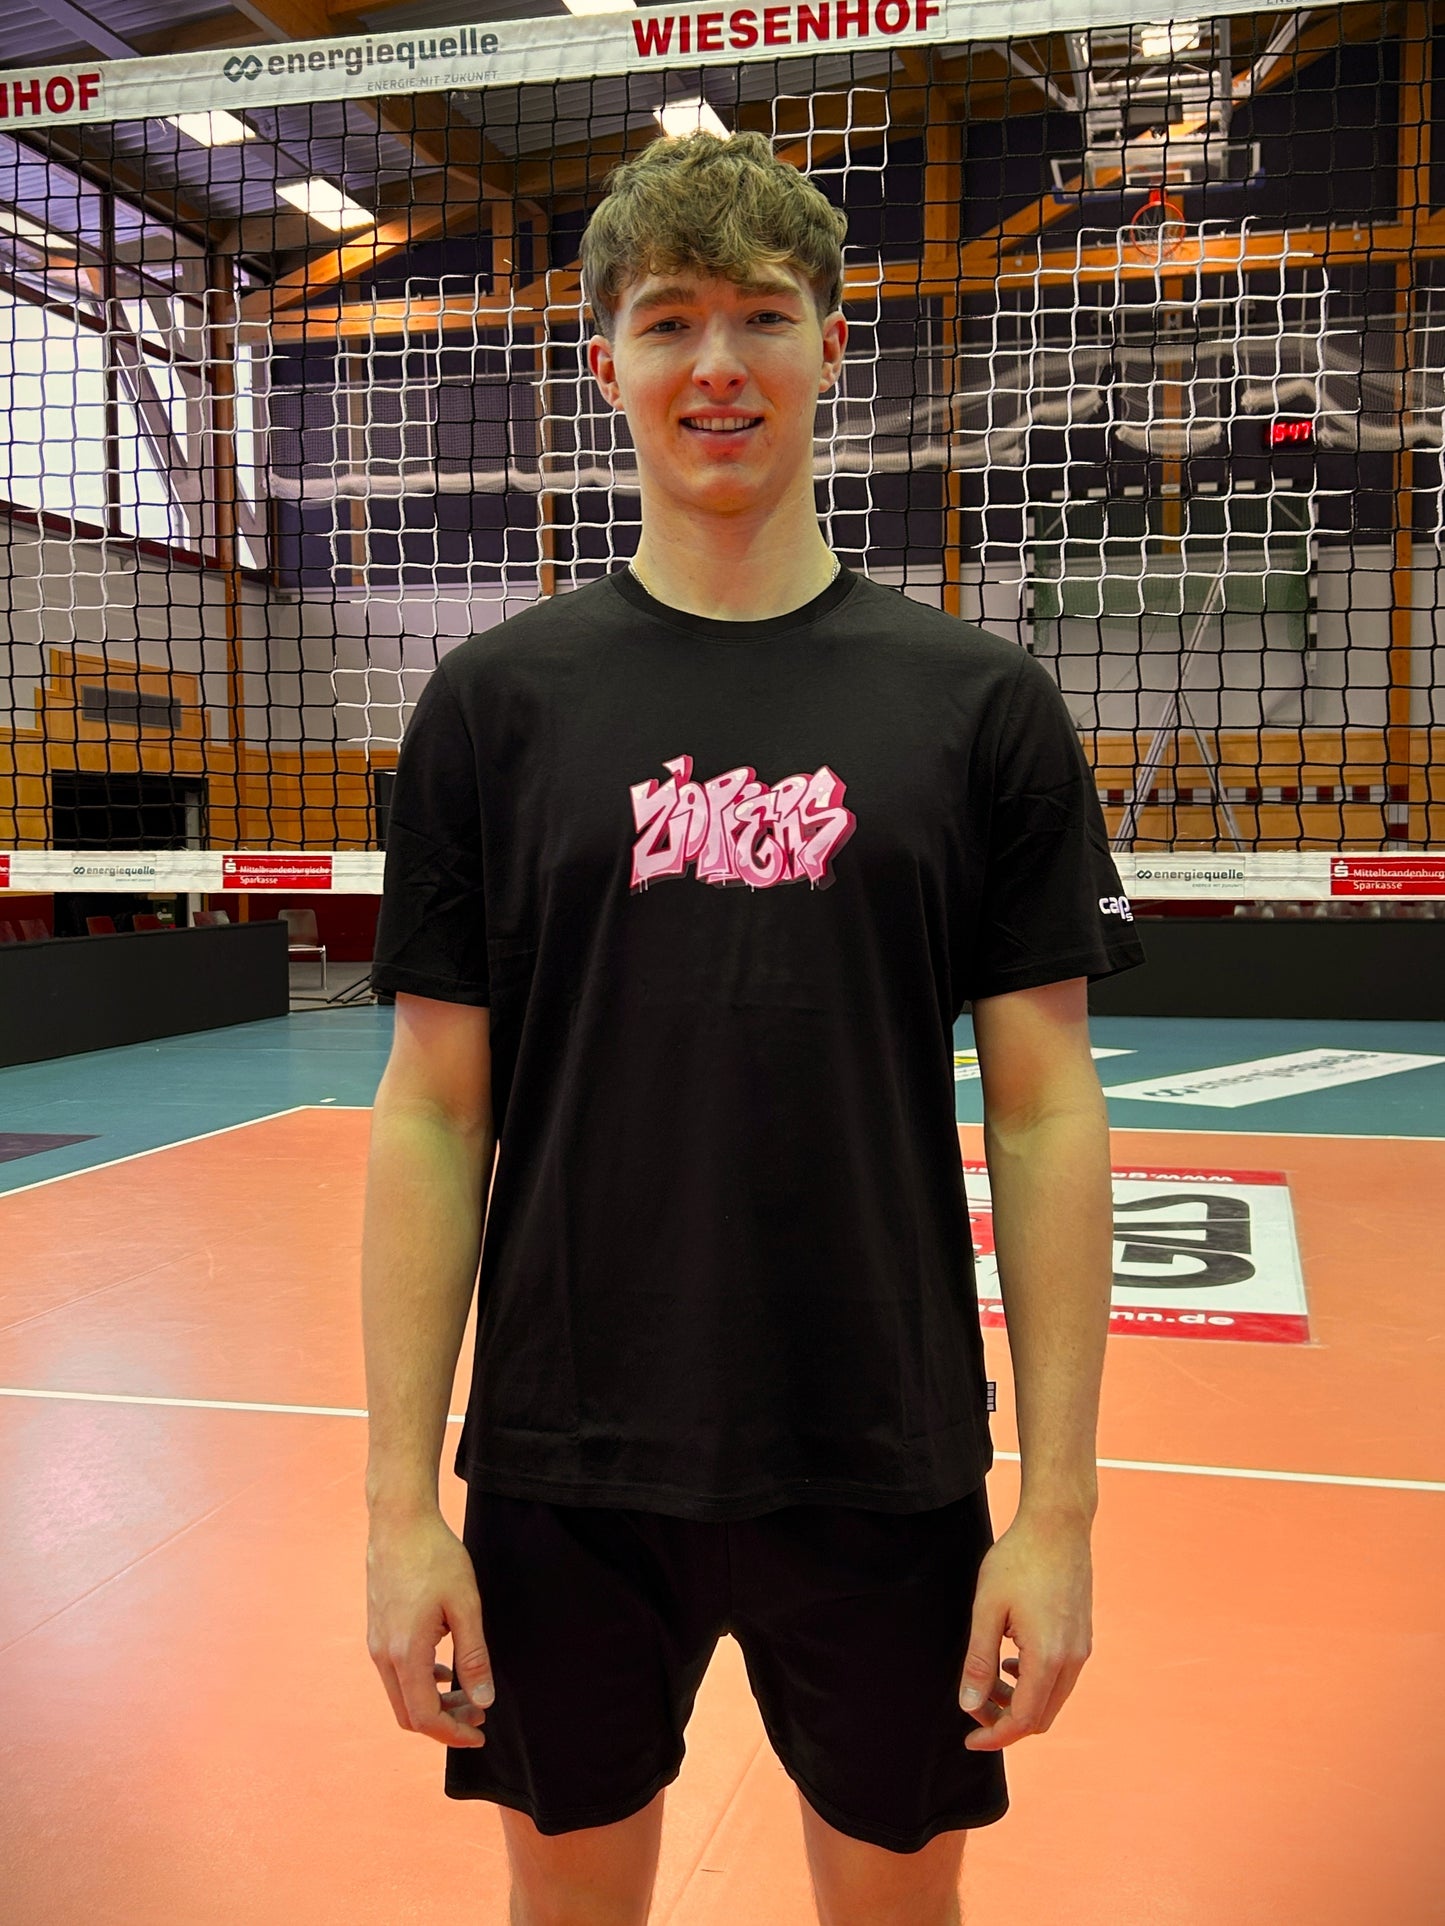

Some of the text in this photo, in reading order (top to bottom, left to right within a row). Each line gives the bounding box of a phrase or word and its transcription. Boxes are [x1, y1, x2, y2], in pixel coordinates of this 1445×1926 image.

[632, 0, 939, 58] WIESENHOF
[268, 28, 498, 76] energiequelle
[367, 70, 498, 92] ENERGIE MIT ZUKUNFT
[0, 73, 100, 118] HOF
[86, 866, 156, 877] energiequelle
[240, 866, 330, 875] Mittelbrandenburgische
[1154, 869, 1244, 881] energiequelle
[240, 875, 279, 885] Sparkasse
[1353, 881, 1403, 891] Sparkasse
